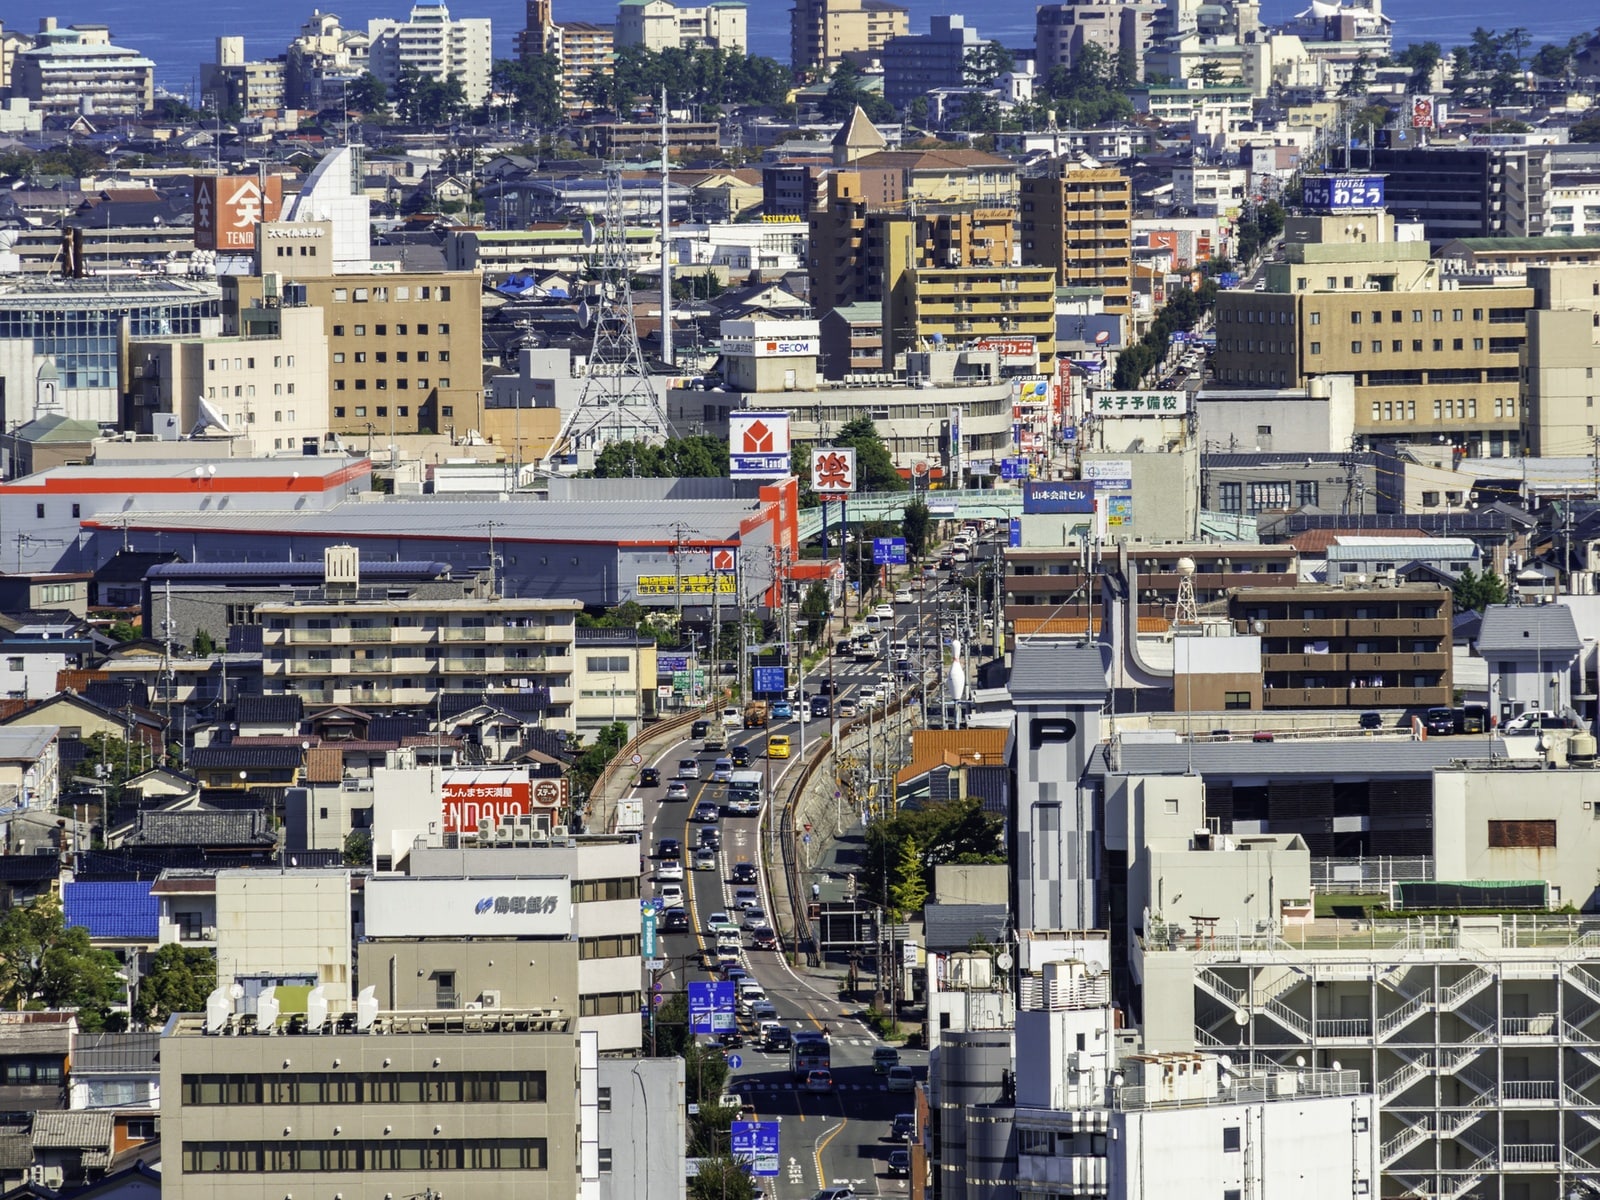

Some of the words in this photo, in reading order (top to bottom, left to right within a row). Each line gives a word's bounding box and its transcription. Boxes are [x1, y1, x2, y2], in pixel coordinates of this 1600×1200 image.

[1334, 179, 1365, 188] HOTEL
[1304, 188, 1329, 204] わこう
[1334, 188, 1380, 204] わこう
[762, 215, 801, 224] TSUTAYA
[779, 343, 809, 352] SECOM
[1098, 395, 1178, 410] 米子予備校
[815, 452, 851, 488] 楽
[1032, 491, 1086, 500] 山本会計ビル
[1030, 718, 1076, 750] P
[537, 788, 557, 796] ステーキ
[493, 896, 558, 914] 鳥取銀行
